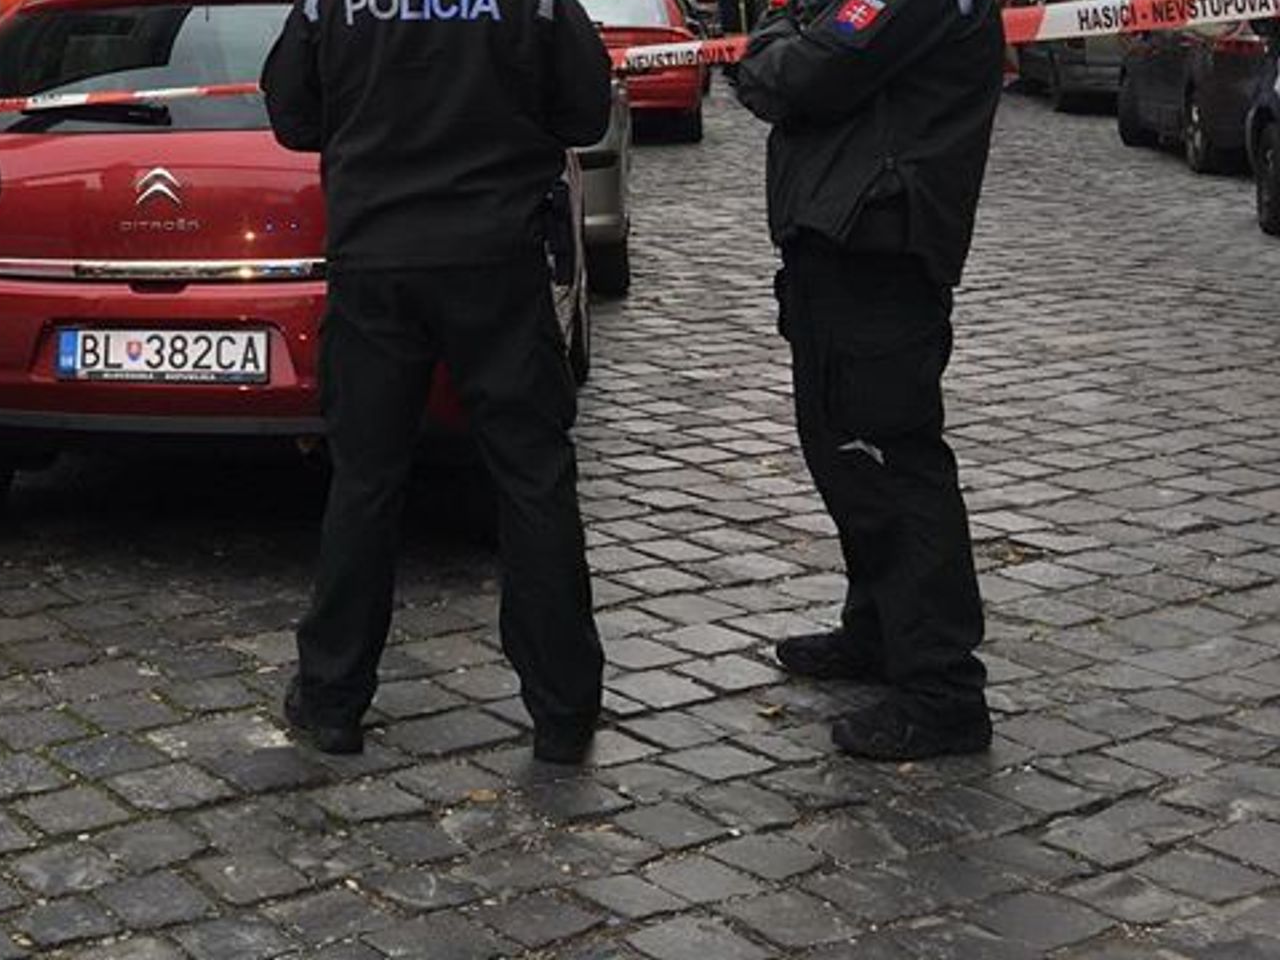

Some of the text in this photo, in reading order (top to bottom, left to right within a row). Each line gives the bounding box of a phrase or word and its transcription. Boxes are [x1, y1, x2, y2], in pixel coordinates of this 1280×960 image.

[1077, 1, 1136, 31] HASIČI
[81, 334, 260, 371] BL 382CA
